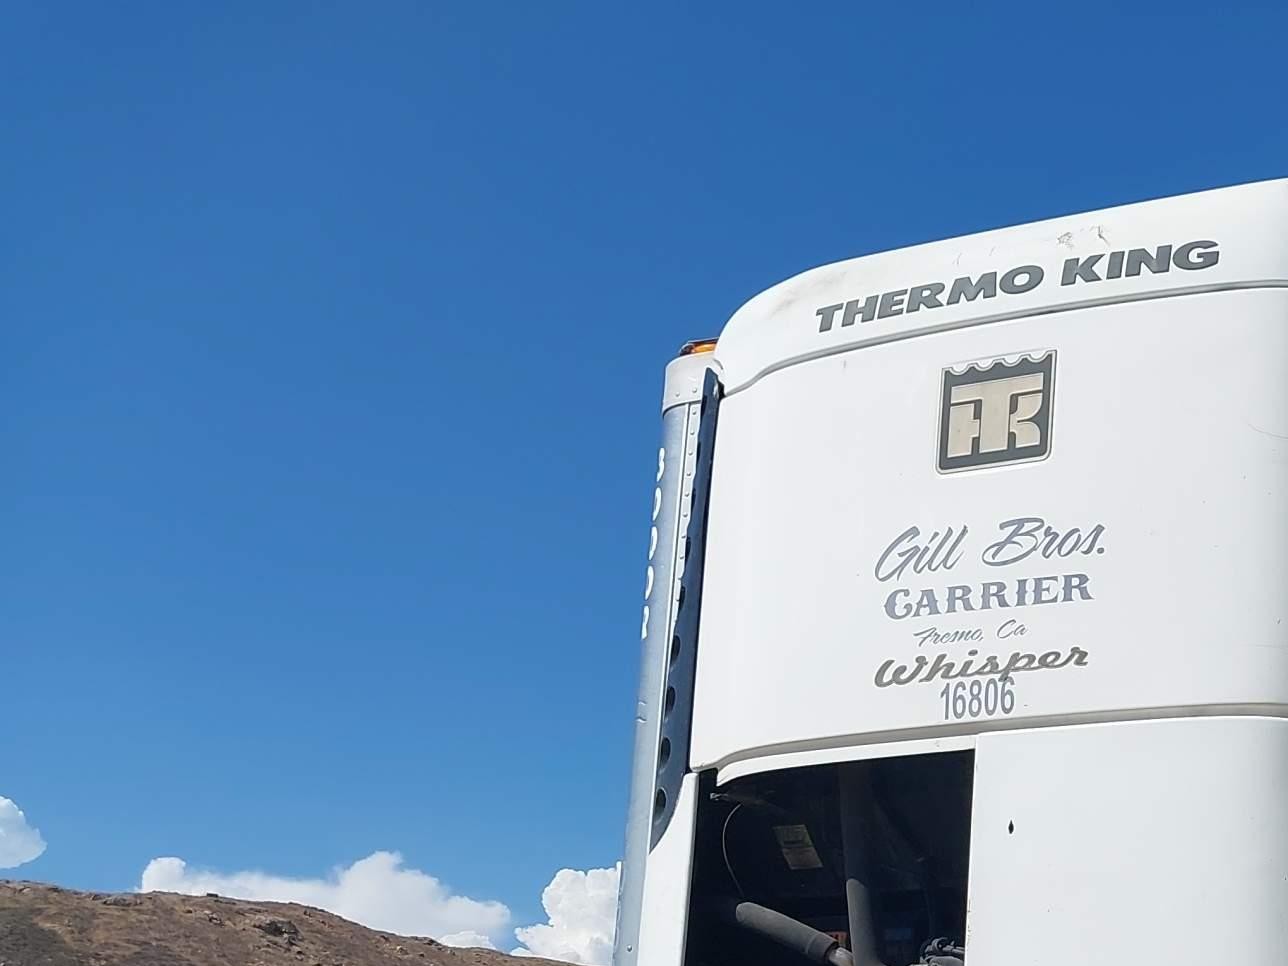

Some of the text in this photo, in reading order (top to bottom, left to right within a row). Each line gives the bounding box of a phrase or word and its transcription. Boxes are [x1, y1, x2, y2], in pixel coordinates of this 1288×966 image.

[815, 239, 1220, 333] THERMO KING
[874, 516, 1106, 583] Gill Bros.
[883, 573, 1096, 620] CARRIER
[996, 618, 1028, 639] Ca
[874, 646, 1089, 688] Whisper
[939, 675, 1016, 721] 16806
